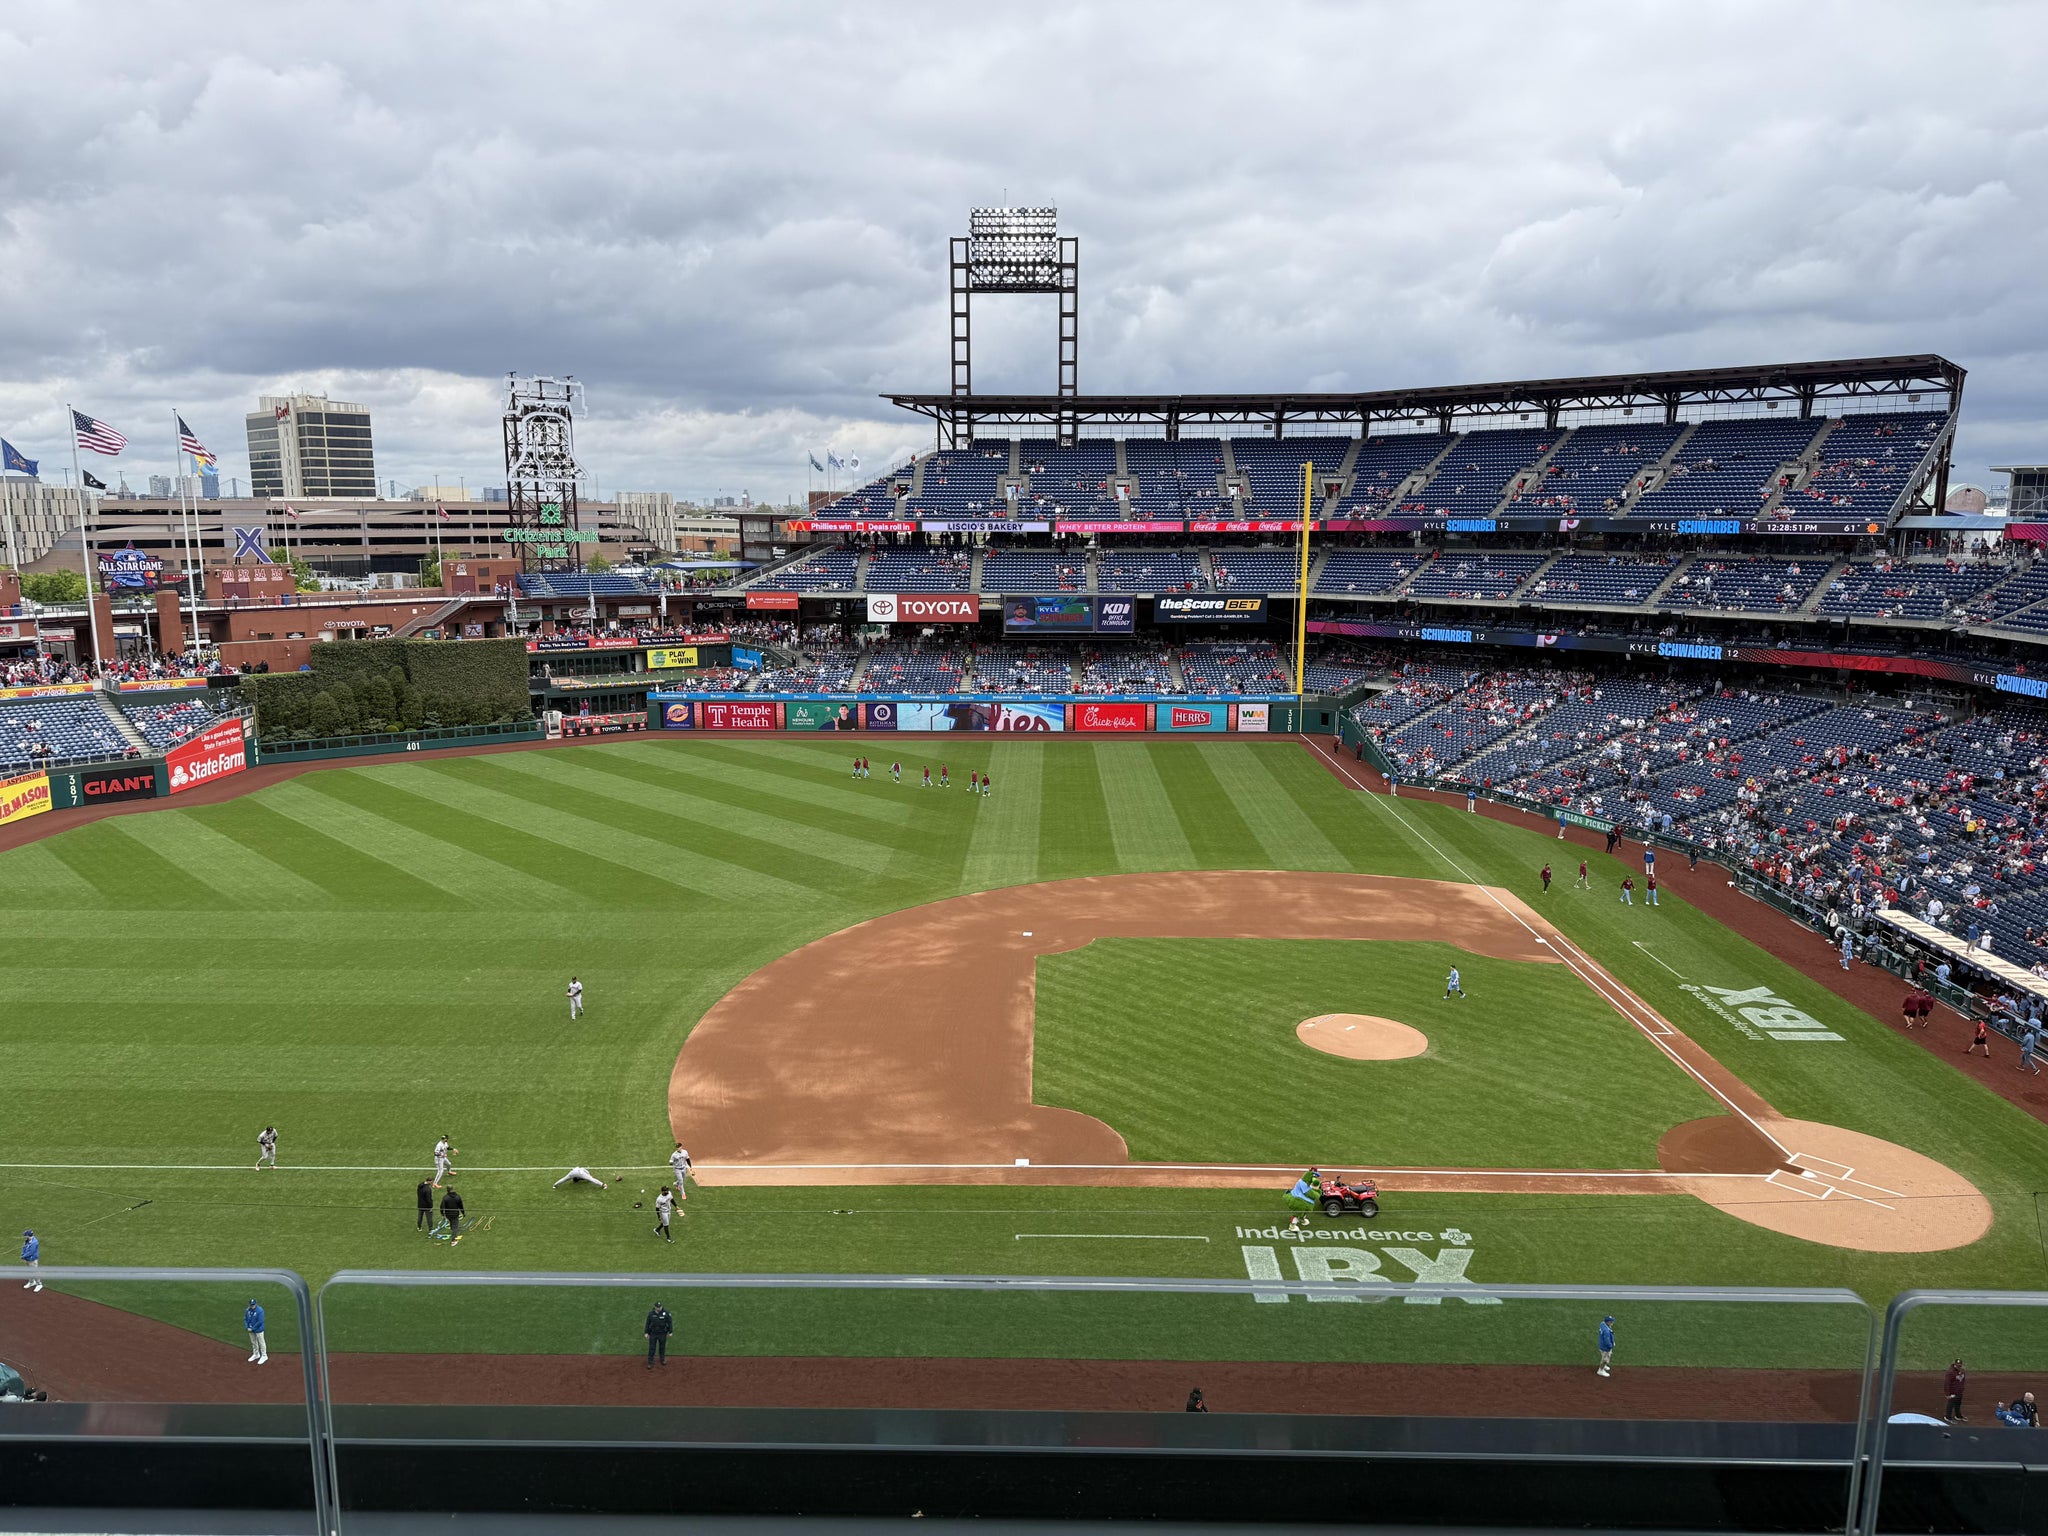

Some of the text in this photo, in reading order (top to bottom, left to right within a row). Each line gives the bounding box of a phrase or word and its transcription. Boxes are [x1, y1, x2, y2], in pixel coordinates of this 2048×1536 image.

[868, 523, 910, 531] Deals roll in
[947, 523, 1023, 531] LISCIO'S BAKERY
[1446, 519, 1496, 532] SCHWARBER
[1677, 520, 1740, 534] SCHWARBER
[1745, 523, 1756, 531] 12
[1767, 524, 1803, 532] 12:28:51
[503, 528, 599, 543] Citizens Bank
[537, 545, 568, 558] Park
[140, 561, 164, 571] GAME
[902, 601, 972, 615] TOYOTA
[1102, 603, 1130, 614] KDI
[1160, 599, 1258, 610] theScore BET
[1399, 629, 1420, 637] KYLE
[1421, 628, 1472, 643] SCHWARBER
[669, 651, 686, 659] PLAY
[1630, 642, 1738, 660] KYLE SCHWARBER 12
[677, 657, 694, 665] WIN!
[32, 686, 67, 698] Surfside
[1974, 673, 2048, 699] KYLE SCHWARBER
[730, 705, 771, 716] Temple
[1242, 710, 1265, 718] WM
[731, 717, 769, 727] Health
[1175, 712, 1206, 723] HERR'S
[201, 734, 210, 742] Like
[213, 731, 224, 740] good
[204, 743, 215, 751] State
[406, 742, 420, 751] 401
[7, 772, 41, 786] ASPLUNDH
[84, 775, 154, 795] GIANT
[68, 774, 78, 806] 387
[1585, 818, 1614, 832] PICKLES
[1691, 988, 1764, 1041] Independence
[1702, 985, 1847, 1041] IBX
[1235, 1226, 1434, 1243] Independence
[1241, 1245, 1503, 1305] IBX
